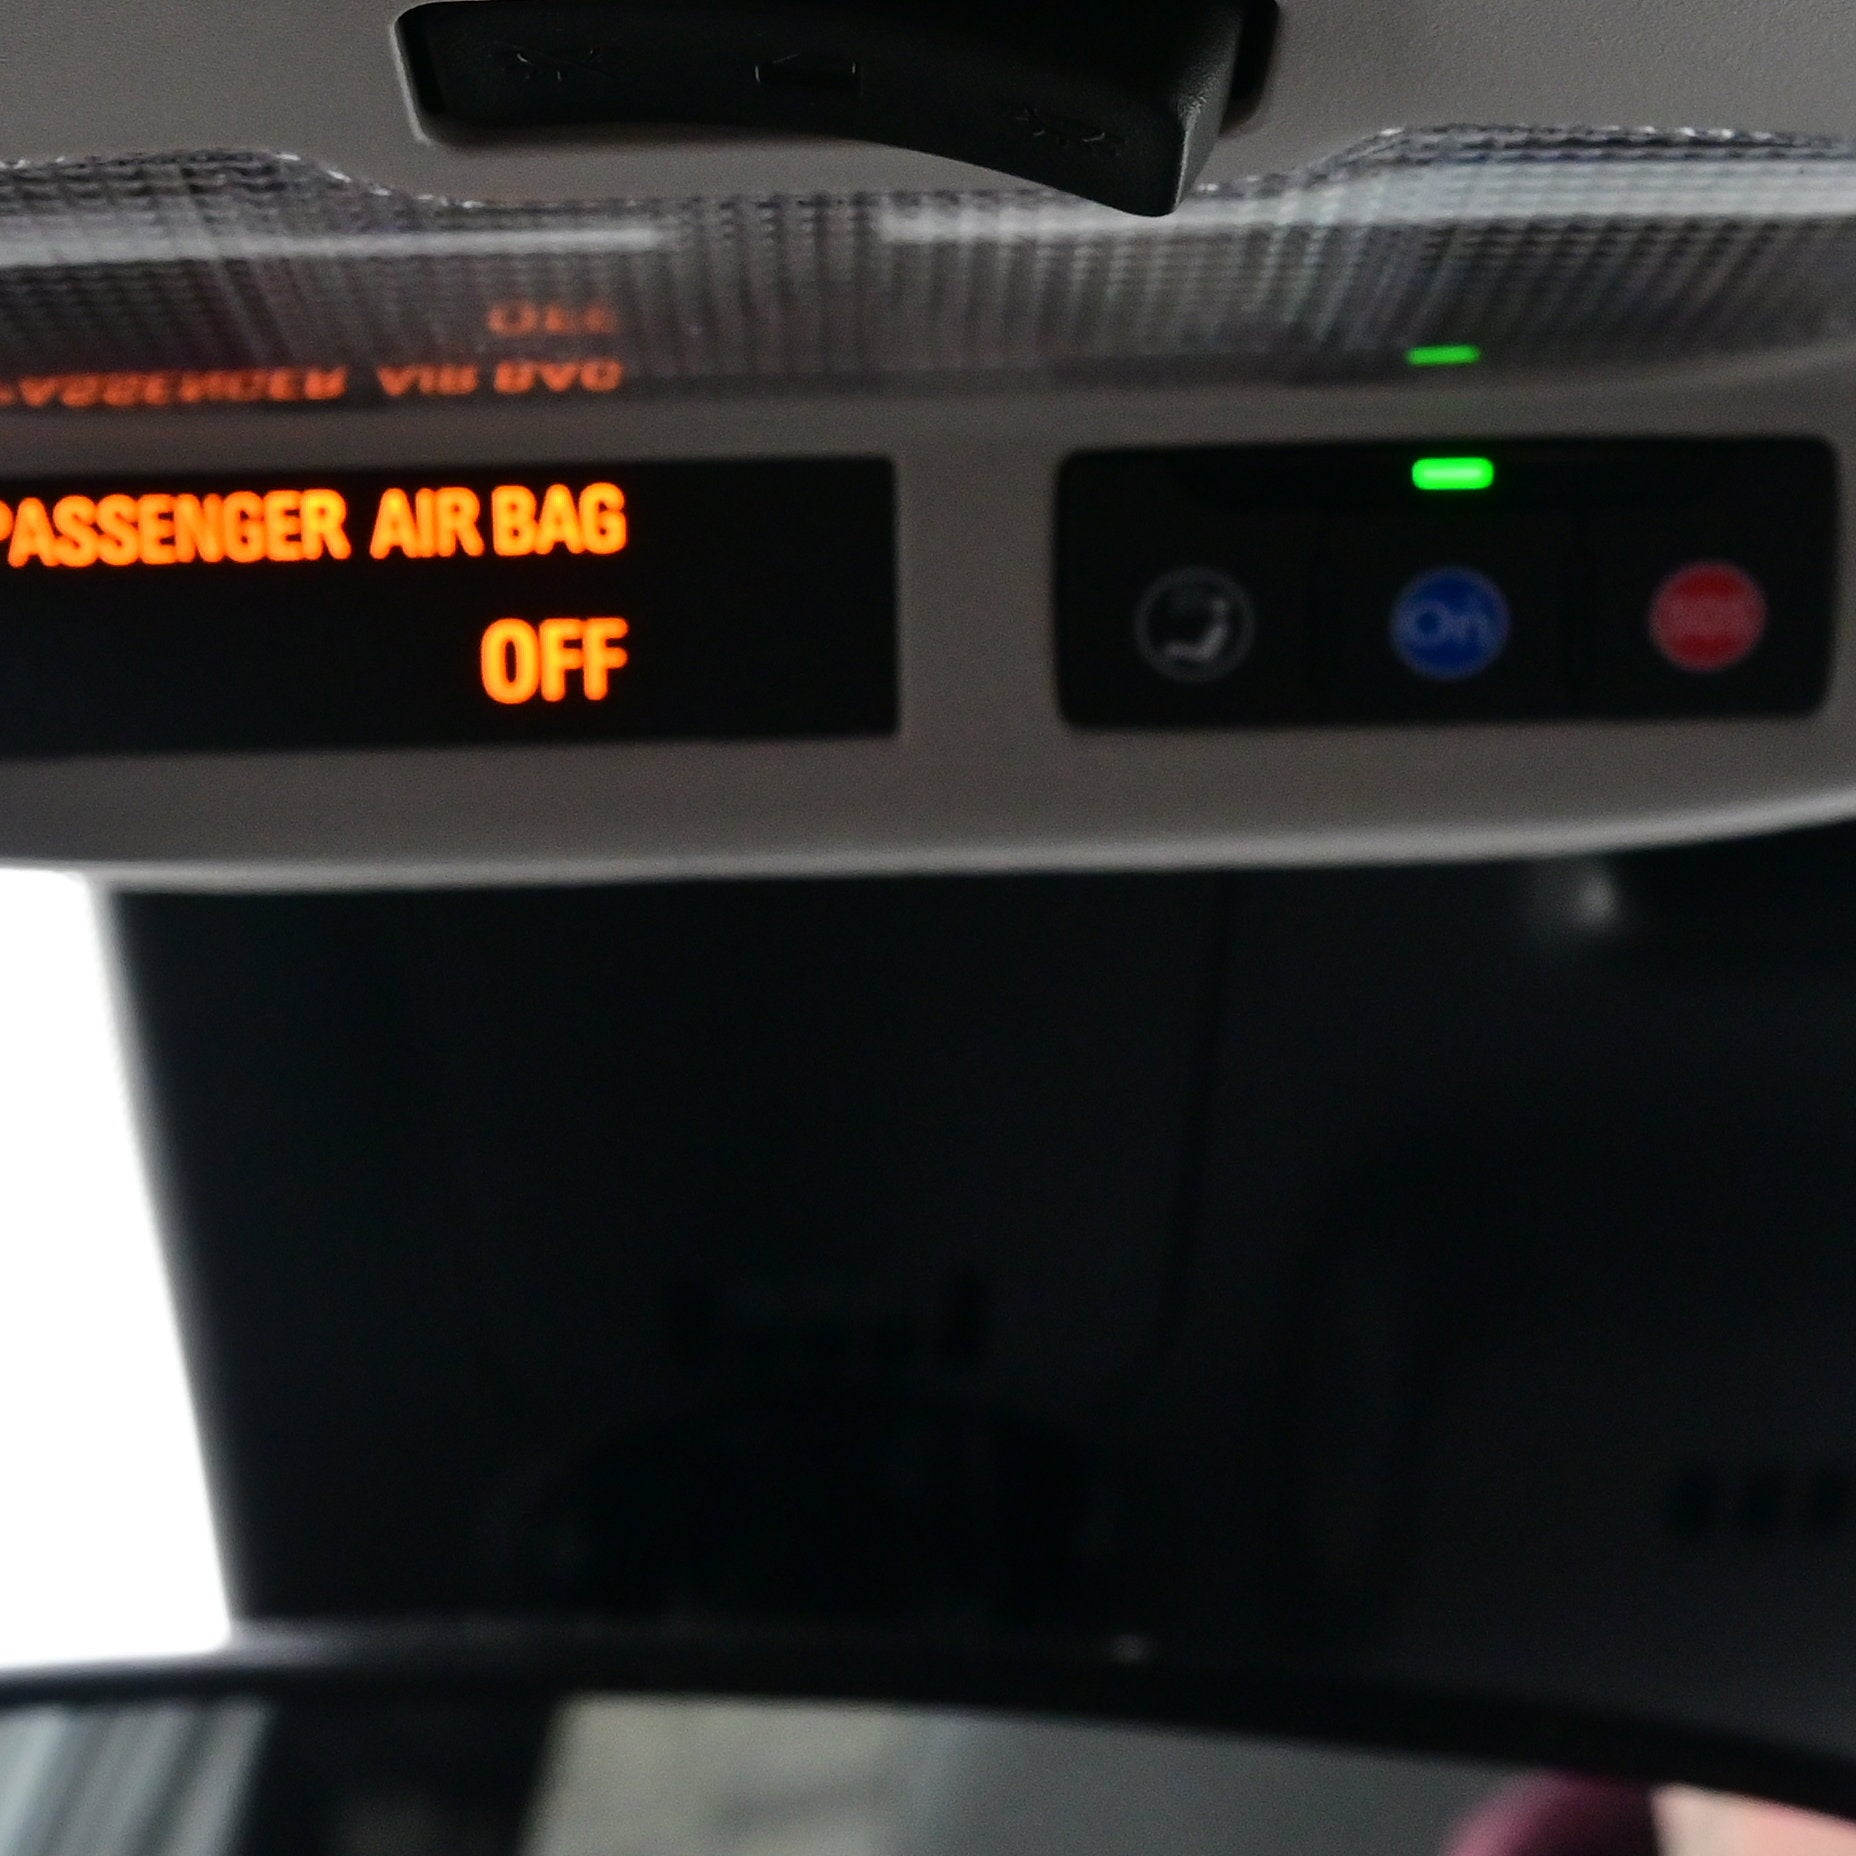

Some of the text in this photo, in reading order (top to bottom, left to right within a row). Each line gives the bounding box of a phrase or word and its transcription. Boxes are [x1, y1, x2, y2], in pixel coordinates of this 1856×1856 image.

[368, 485, 487, 560] AIR
[489, 480, 629, 557] BAG
[479, 615, 630, 706] OFF
